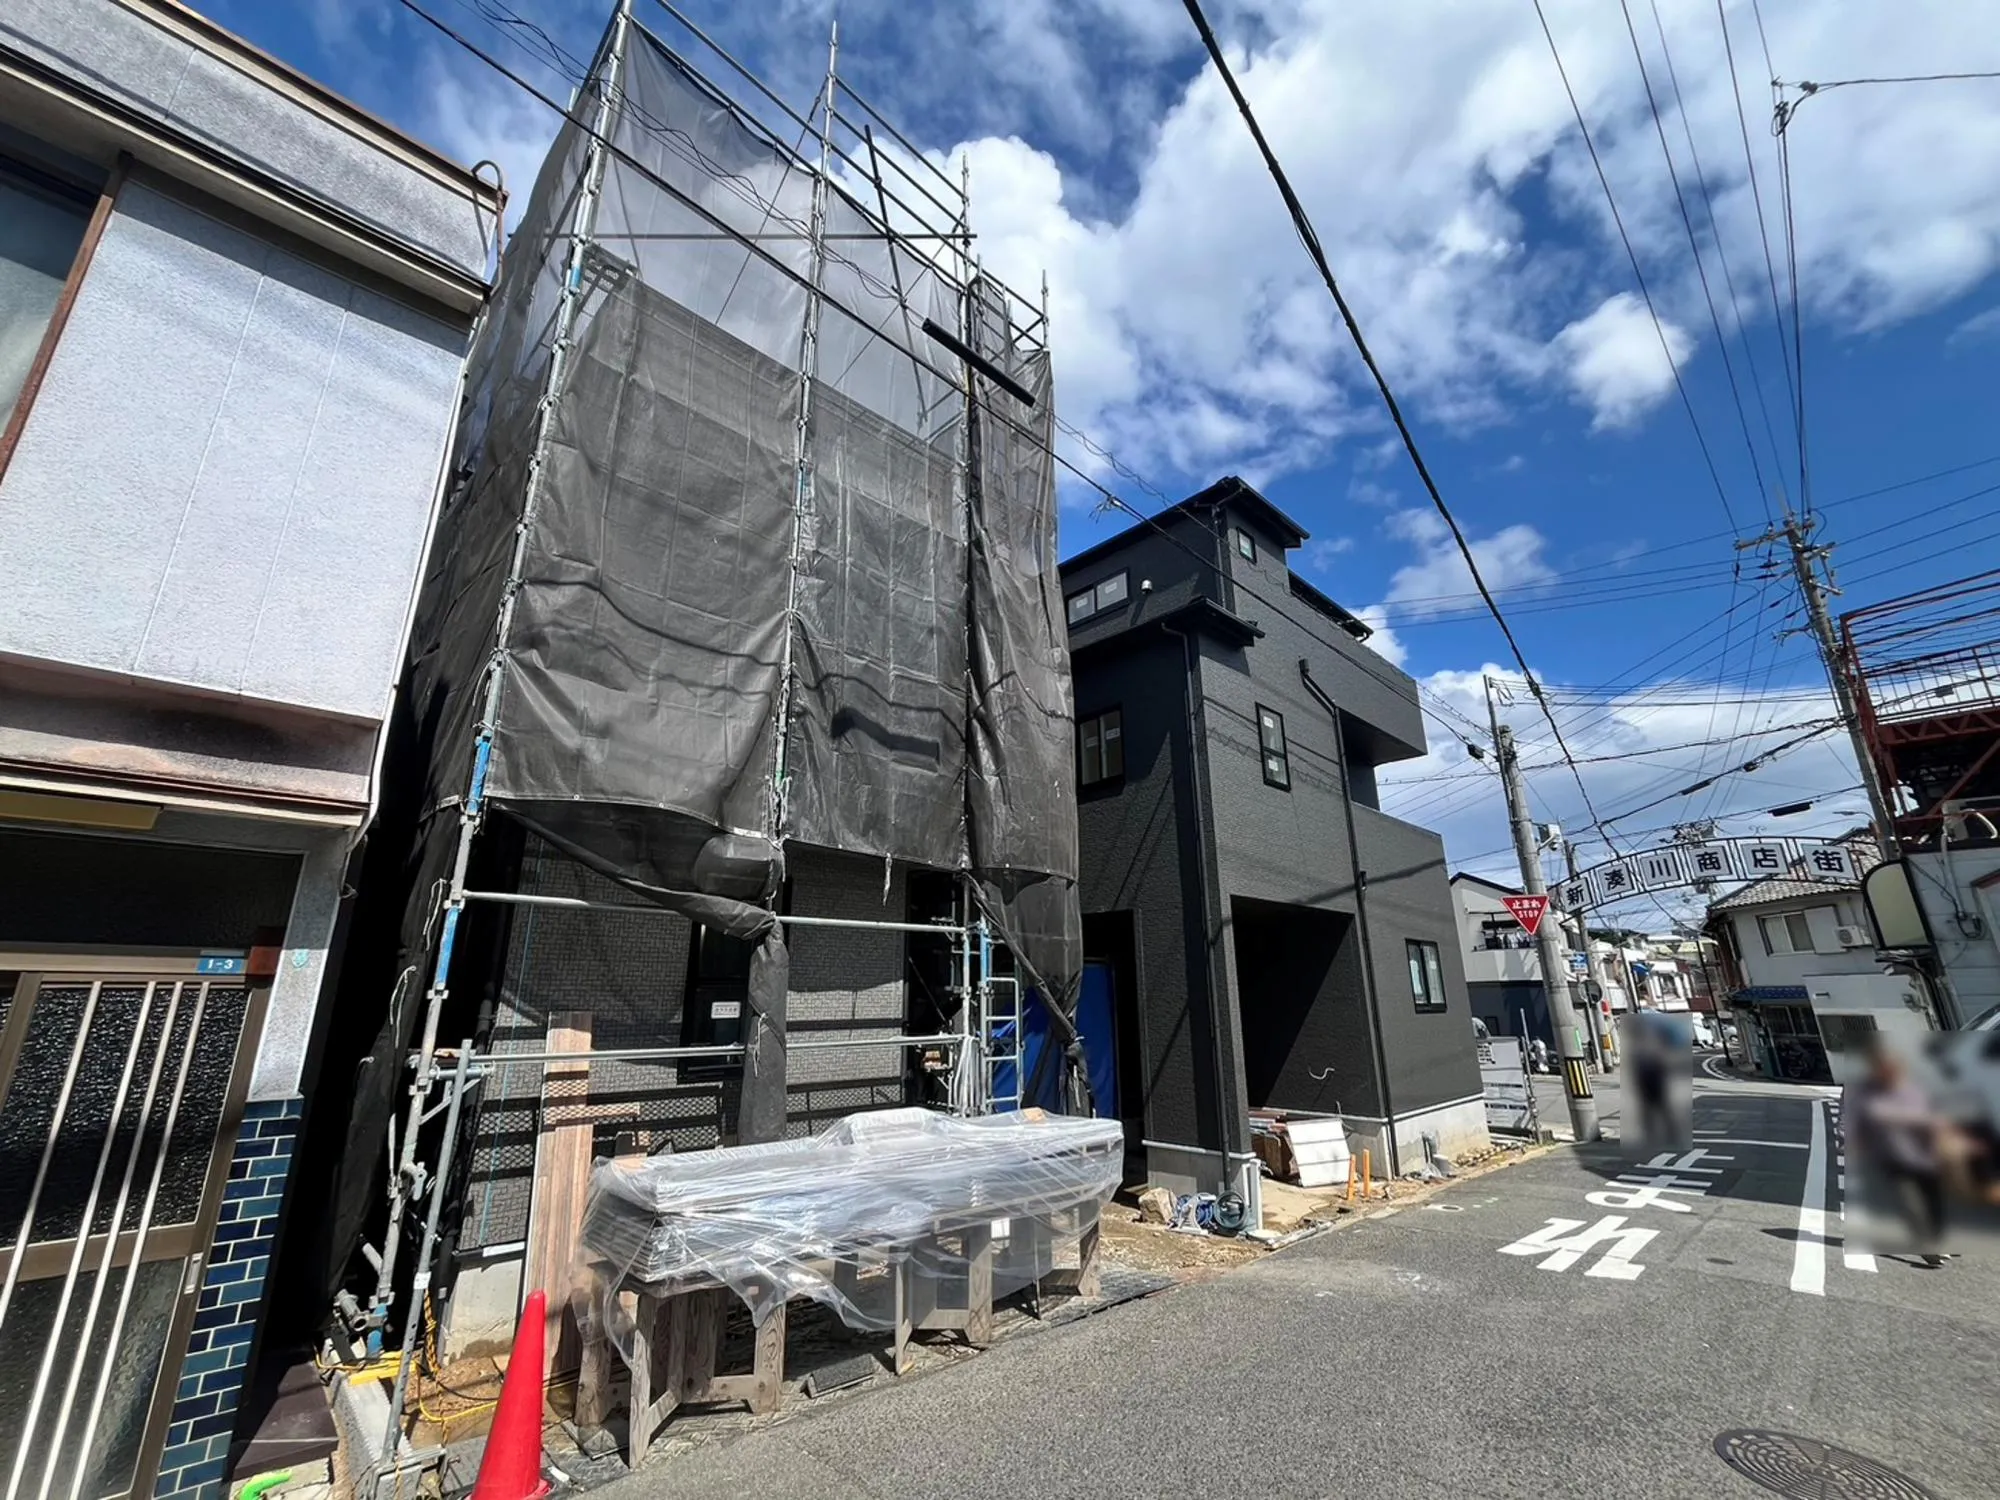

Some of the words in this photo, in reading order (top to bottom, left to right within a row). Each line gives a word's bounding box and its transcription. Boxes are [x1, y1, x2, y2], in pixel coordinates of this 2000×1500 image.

[1566, 847, 1844, 906] 新湊川商店街
[1512, 899, 1541, 909] 止まれ
[1518, 910, 1539, 918] STOP
[208, 959, 234, 969] 1-3
